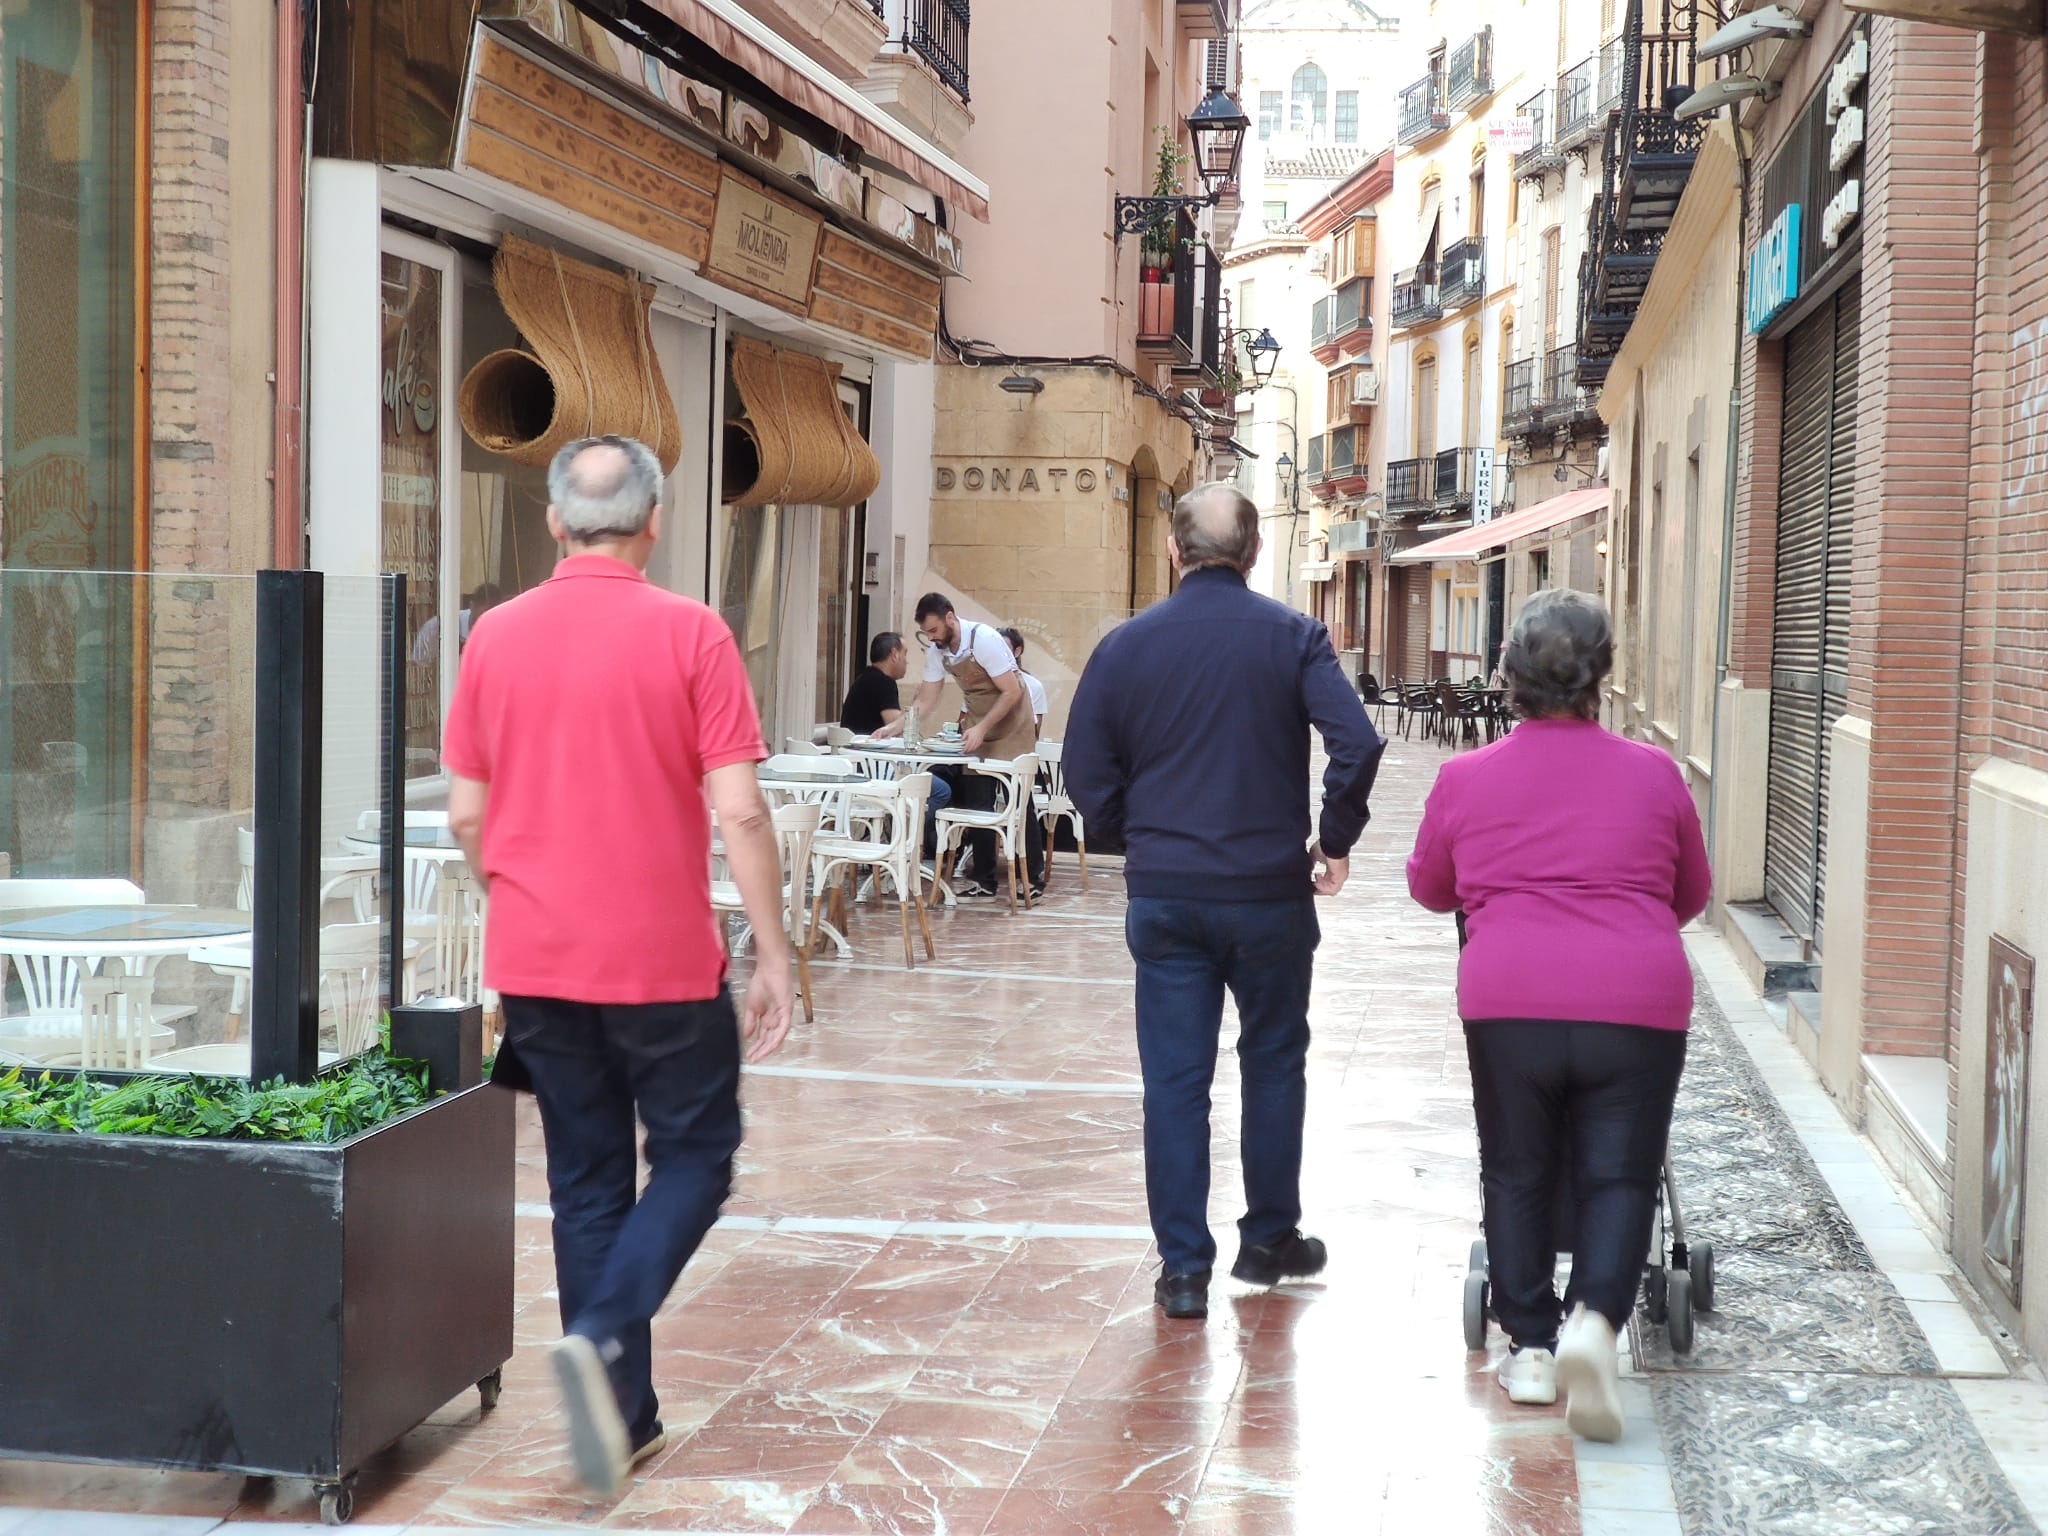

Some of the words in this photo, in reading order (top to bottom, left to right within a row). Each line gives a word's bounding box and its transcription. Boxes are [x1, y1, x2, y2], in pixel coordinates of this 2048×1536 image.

[763, 203, 774, 223] LA
[736, 220, 789, 269] MOLIENDA
[381, 323, 416, 434] afé
[936, 466, 1097, 493] DONATO
